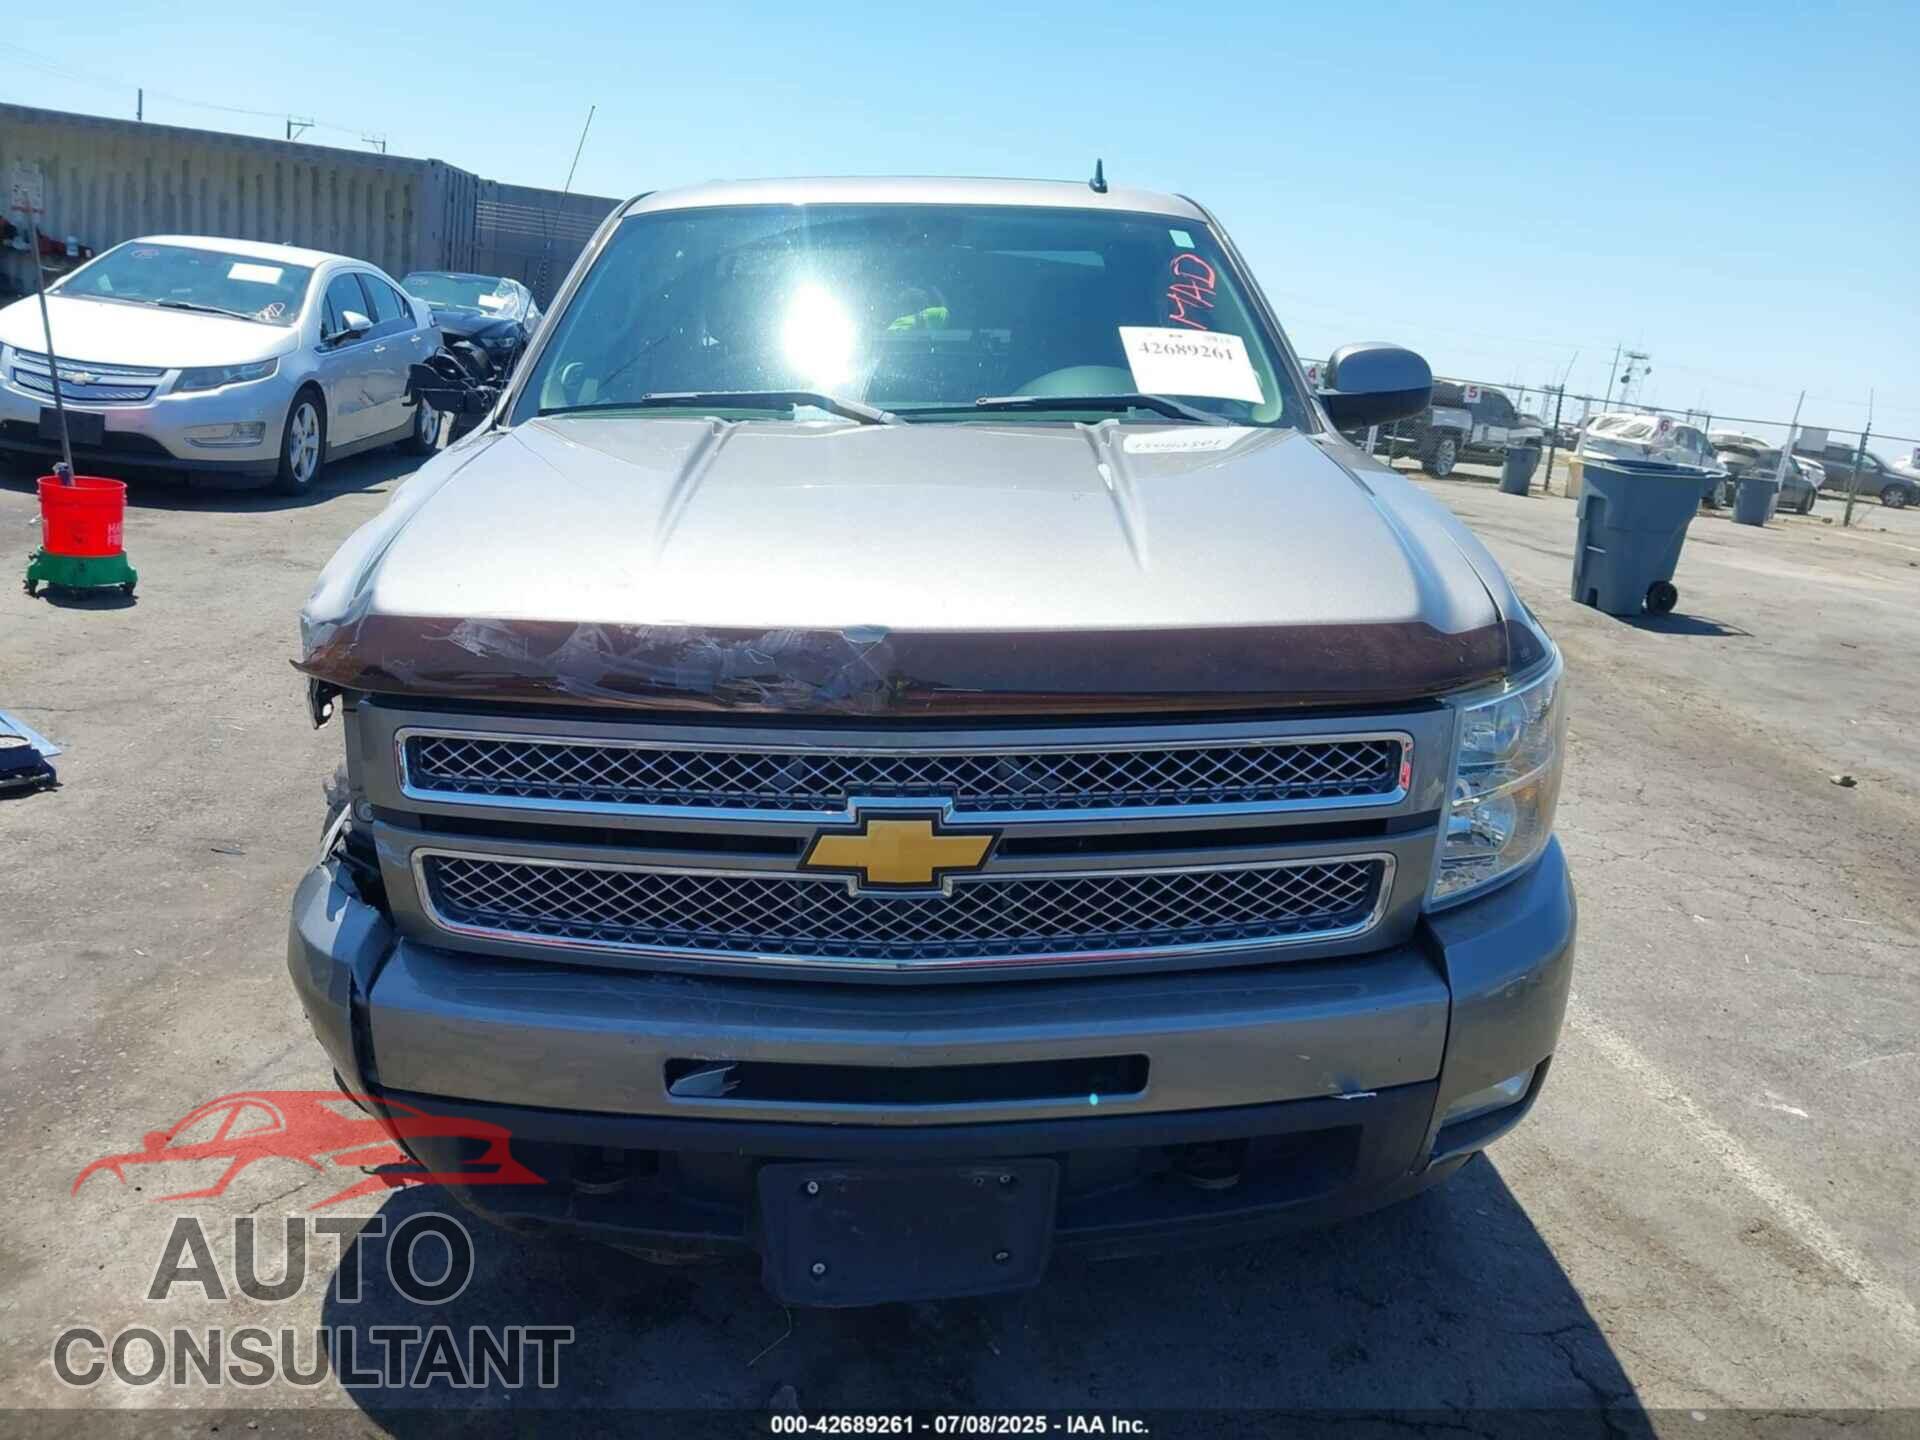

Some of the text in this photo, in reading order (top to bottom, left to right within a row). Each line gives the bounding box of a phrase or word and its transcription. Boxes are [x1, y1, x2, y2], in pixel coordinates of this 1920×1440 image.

[1138, 341, 1233, 361] 42689261
[1468, 385, 1478, 399] 5
[1660, 419, 1670, 431] 6
